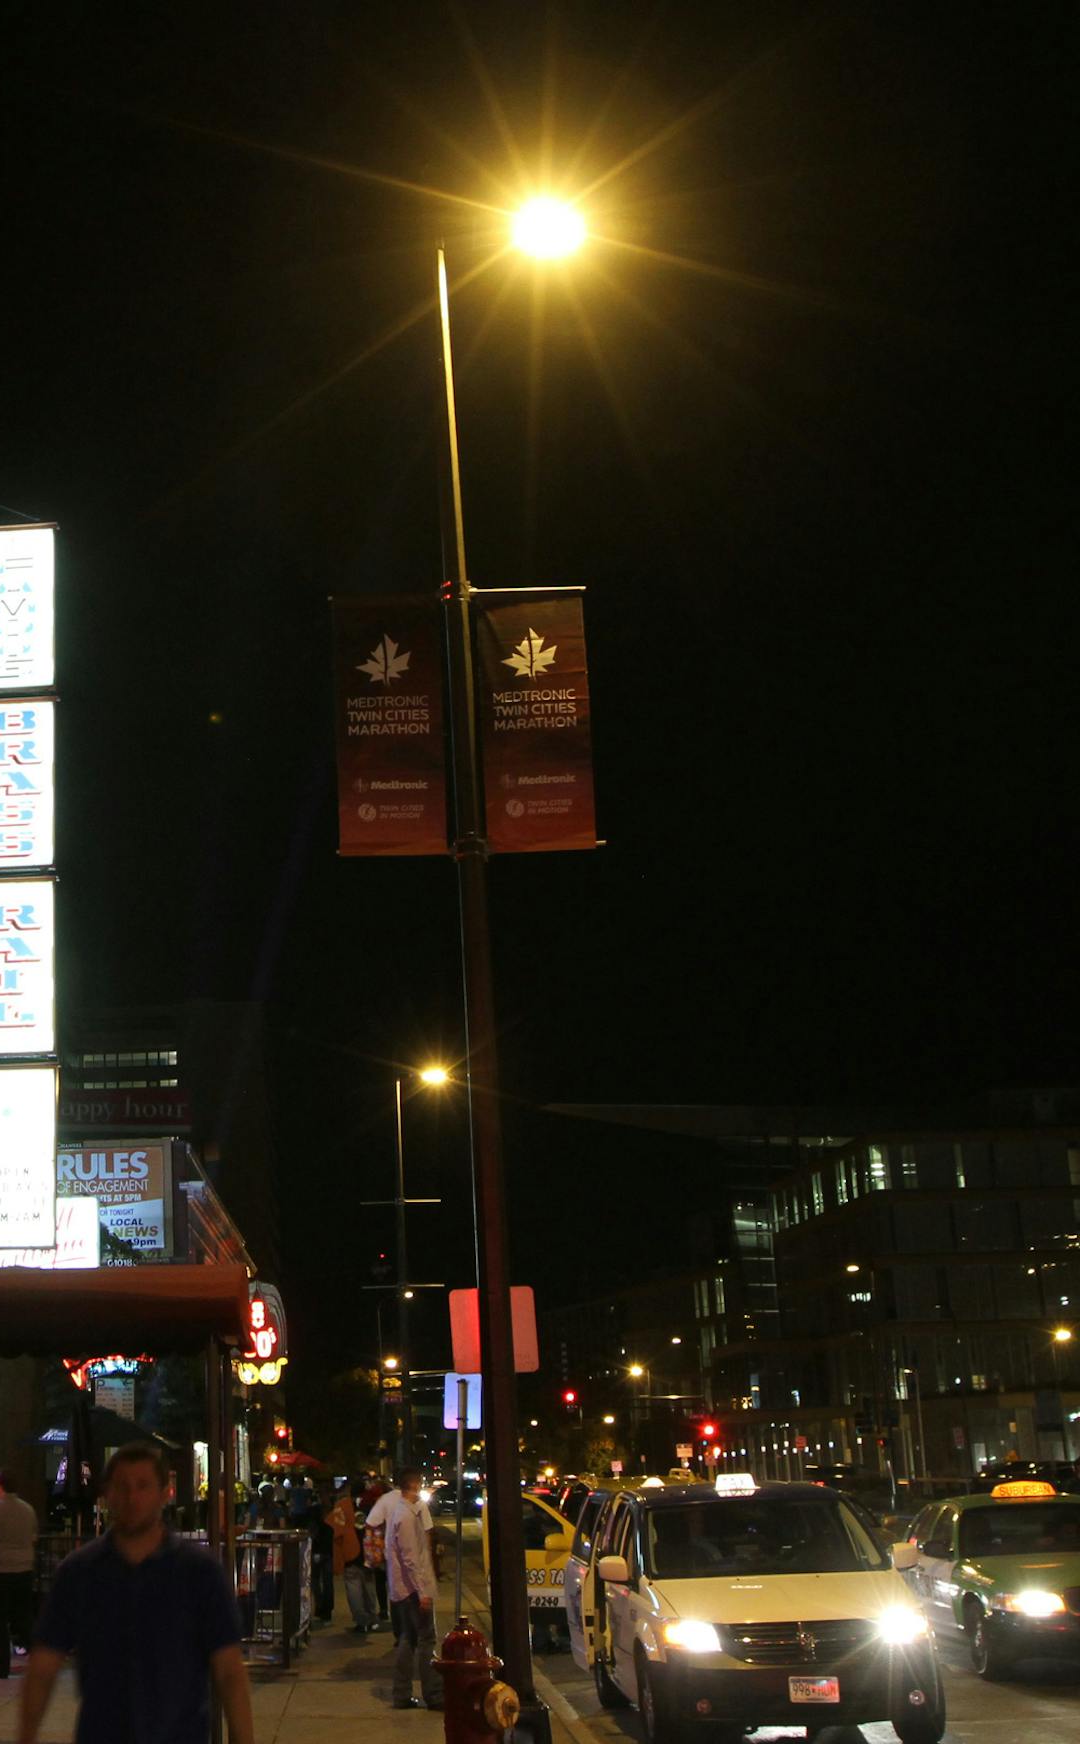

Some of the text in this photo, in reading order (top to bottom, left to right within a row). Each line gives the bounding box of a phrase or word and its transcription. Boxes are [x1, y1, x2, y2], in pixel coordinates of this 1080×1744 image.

[347, 695, 428, 709] MEDTRONIC
[492, 688, 576, 703] MEDTRONIC
[348, 709, 429, 722] TWIN CITIES
[493, 702, 576, 717] TWIN CITIES
[348, 722, 430, 736] MARATHON
[494, 716, 577, 731] MARATHON
[62, 1096, 187, 1122] appy hour
[57, 1152, 148, 1180] RULES
[57, 1179, 149, 1193] OF ENGAGEMENT
[110, 1218, 143, 1226] LOCAL
[113, 1226, 158, 1237] NEWS
